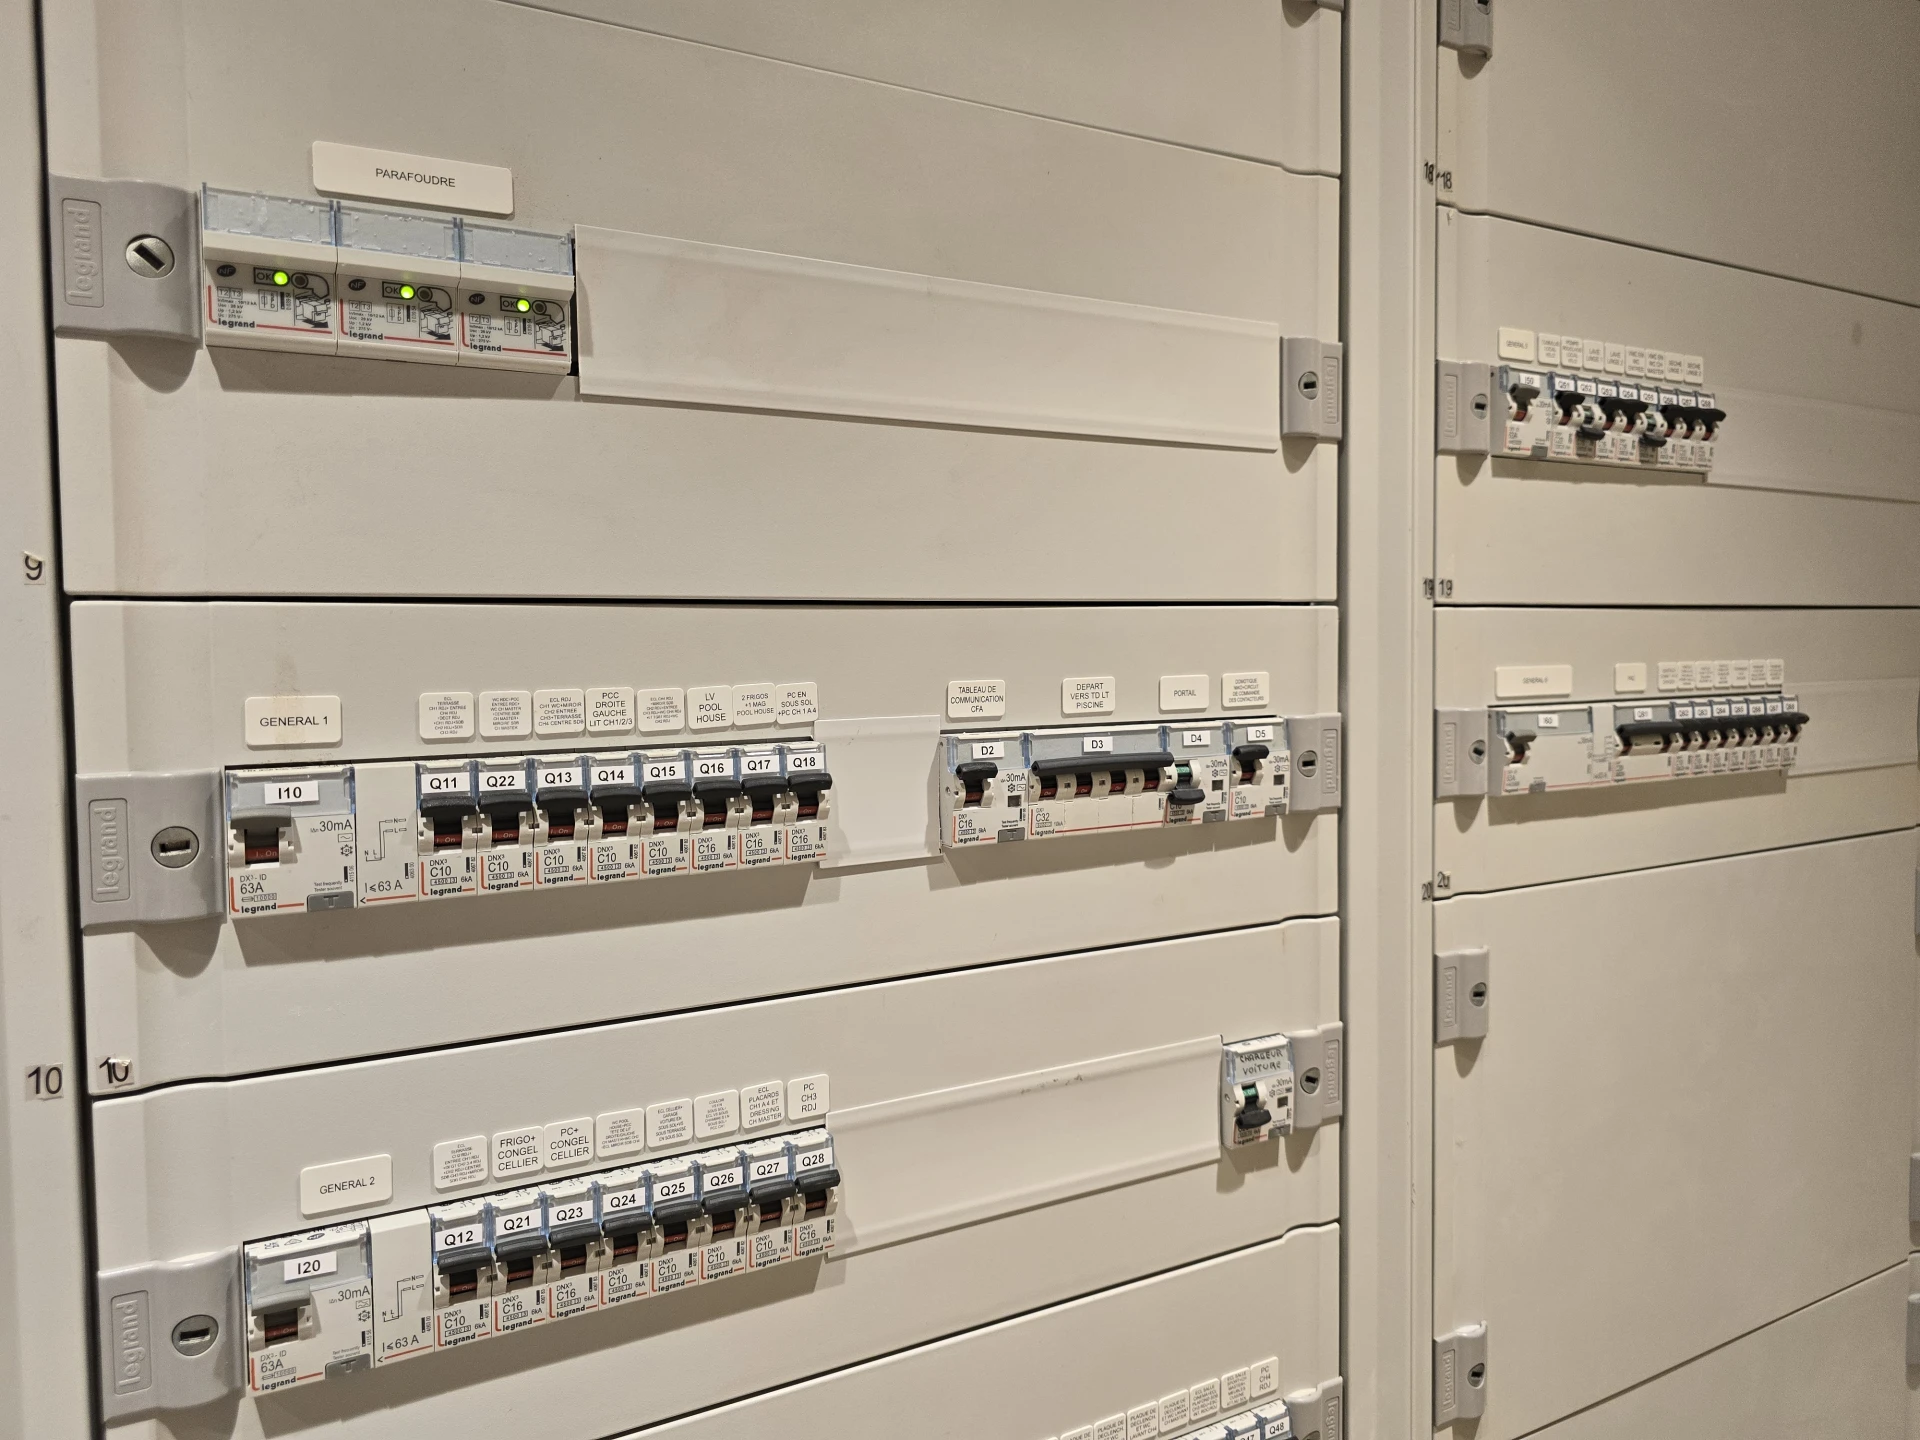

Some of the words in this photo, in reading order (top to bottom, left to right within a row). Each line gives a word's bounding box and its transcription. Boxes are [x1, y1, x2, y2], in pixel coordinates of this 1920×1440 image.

[375, 168, 456, 188] PARAFOUDRE
[1440, 171, 1452, 189] 18
[67, 207, 99, 300] legrand
[219, 266, 234, 275] NF
[256, 272, 271, 281] OK
[385, 286, 400, 294] OK
[502, 300, 516, 308] OK
[218, 317, 256, 328] legrand
[349, 330, 384, 340] legrand
[470, 342, 502, 352] legrand
[1438, 579, 1453, 596] 19
[958, 686, 987, 694] TABLEAU
[987, 685, 997, 693] DE
[1076, 682, 1104, 691] DEPART
[602, 691, 619, 700] PCC
[705, 693, 715, 701] LV
[950, 695, 1004, 704] COMMUNICATION
[1070, 692, 1090, 700] VERS
[1091, 691, 1101, 699] TD
[595, 700, 626, 708] DROITE
[699, 703, 722, 712] POOL
[1076, 701, 1104, 709] PISCINE
[592, 709, 627, 718] GAUCHE
[696, 713, 726, 723] HOUSE
[259, 716, 319, 727] GENERAL
[323, 716, 328, 725] 1
[603, 717, 633, 726] CH1/2/3
[1191, 734, 1202, 743] D4
[1255, 730, 1266, 738] D5
[981, 745, 994, 755] D2
[1091, 740, 1104, 749] D3
[793, 757, 816, 768] Q18
[1210, 759, 1228, 768] 30mA
[1273, 755, 1289, 763] 30mA
[700, 763, 724, 774] Q16
[747, 760, 771, 771] Q17
[598, 770, 624, 782] Q14
[650, 766, 676, 778] Q15
[1006, 773, 1026, 782] 30mA
[429, 777, 457, 790] Q11
[486, 775, 515, 788] Q22
[545, 772, 572, 784] Q13
[278, 786, 302, 799] I10
[1035, 813, 1050, 822] C32
[319, 819, 353, 832] 30mA
[958, 819, 973, 829] C16
[1035, 828, 1055, 836] legrand
[791, 835, 809, 845] C16
[958, 835, 979, 843] legrand
[94, 807, 125, 894] legrand
[698, 843, 716, 854] C16
[597, 853, 617, 864] C10
[745, 856, 771, 865] legrand
[791, 852, 816, 861] legrand
[429, 866, 452, 877] C10
[488, 861, 509, 872] C10
[544, 875, 574, 884] legrand
[240, 882, 264, 894] 63A
[430, 886, 462, 897] legrand
[241, 903, 277, 914] legrand
[1239, 1048, 1283, 1063] CHARGEUR
[99, 1057, 129, 1084] 10
[28, 1066, 62, 1094] 10
[758, 1086, 769, 1094] ECL
[803, 1083, 815, 1091] PC
[748, 1091, 779, 1103] PLACARDS
[801, 1093, 817, 1102] CH3
[749, 1106, 780, 1118] DRESSING
[801, 1103, 817, 1112] RDJ
[758, 1112, 782, 1124] MASTER
[560, 1127, 579, 1137] PC+
[500, 1135, 536, 1148] FRIGO+
[550, 1136, 589, 1150] CONGEL
[498, 1145, 538, 1159] CONGEL
[550, 1147, 590, 1161] CELLIER
[498, 1157, 539, 1171] CELLIER
[802, 1153, 825, 1167] Q28
[756, 1162, 780, 1176] Q27
[710, 1172, 734, 1187] Q26
[319, 1178, 367, 1195] GENERAL
[369, 1176, 375, 1185] 2
[660, 1182, 686, 1197] Q25
[610, 1194, 636, 1208] Q24
[556, 1207, 583, 1222] Q23
[503, 1216, 531, 1231] Q21
[444, 1230, 473, 1246] Q12
[799, 1230, 816, 1242] C16
[755, 1240, 773, 1253] C10
[799, 1245, 824, 1257] legrand
[297, 1260, 321, 1275] I20
[707, 1267, 733, 1280] legrand
[608, 1274, 628, 1288] C10
[337, 1285, 370, 1302] 30mA
[502, 1301, 523, 1315] C16
[556, 1304, 586, 1318] legrand
[444, 1316, 466, 1330] C10
[116, 1299, 145, 1387] legrand
[444, 1333, 476, 1347] legrand
[260, 1359, 284, 1373] 63A
[1261, 1365, 1269, 1374] PC
[261, 1377, 296, 1391] legrand
[1259, 1374, 1271, 1383] CH4
[1259, 1382, 1270, 1391] RDJ
[1130, 1411, 1148, 1421] PLAQUE
[1269, 1422, 1284, 1434] Q48
